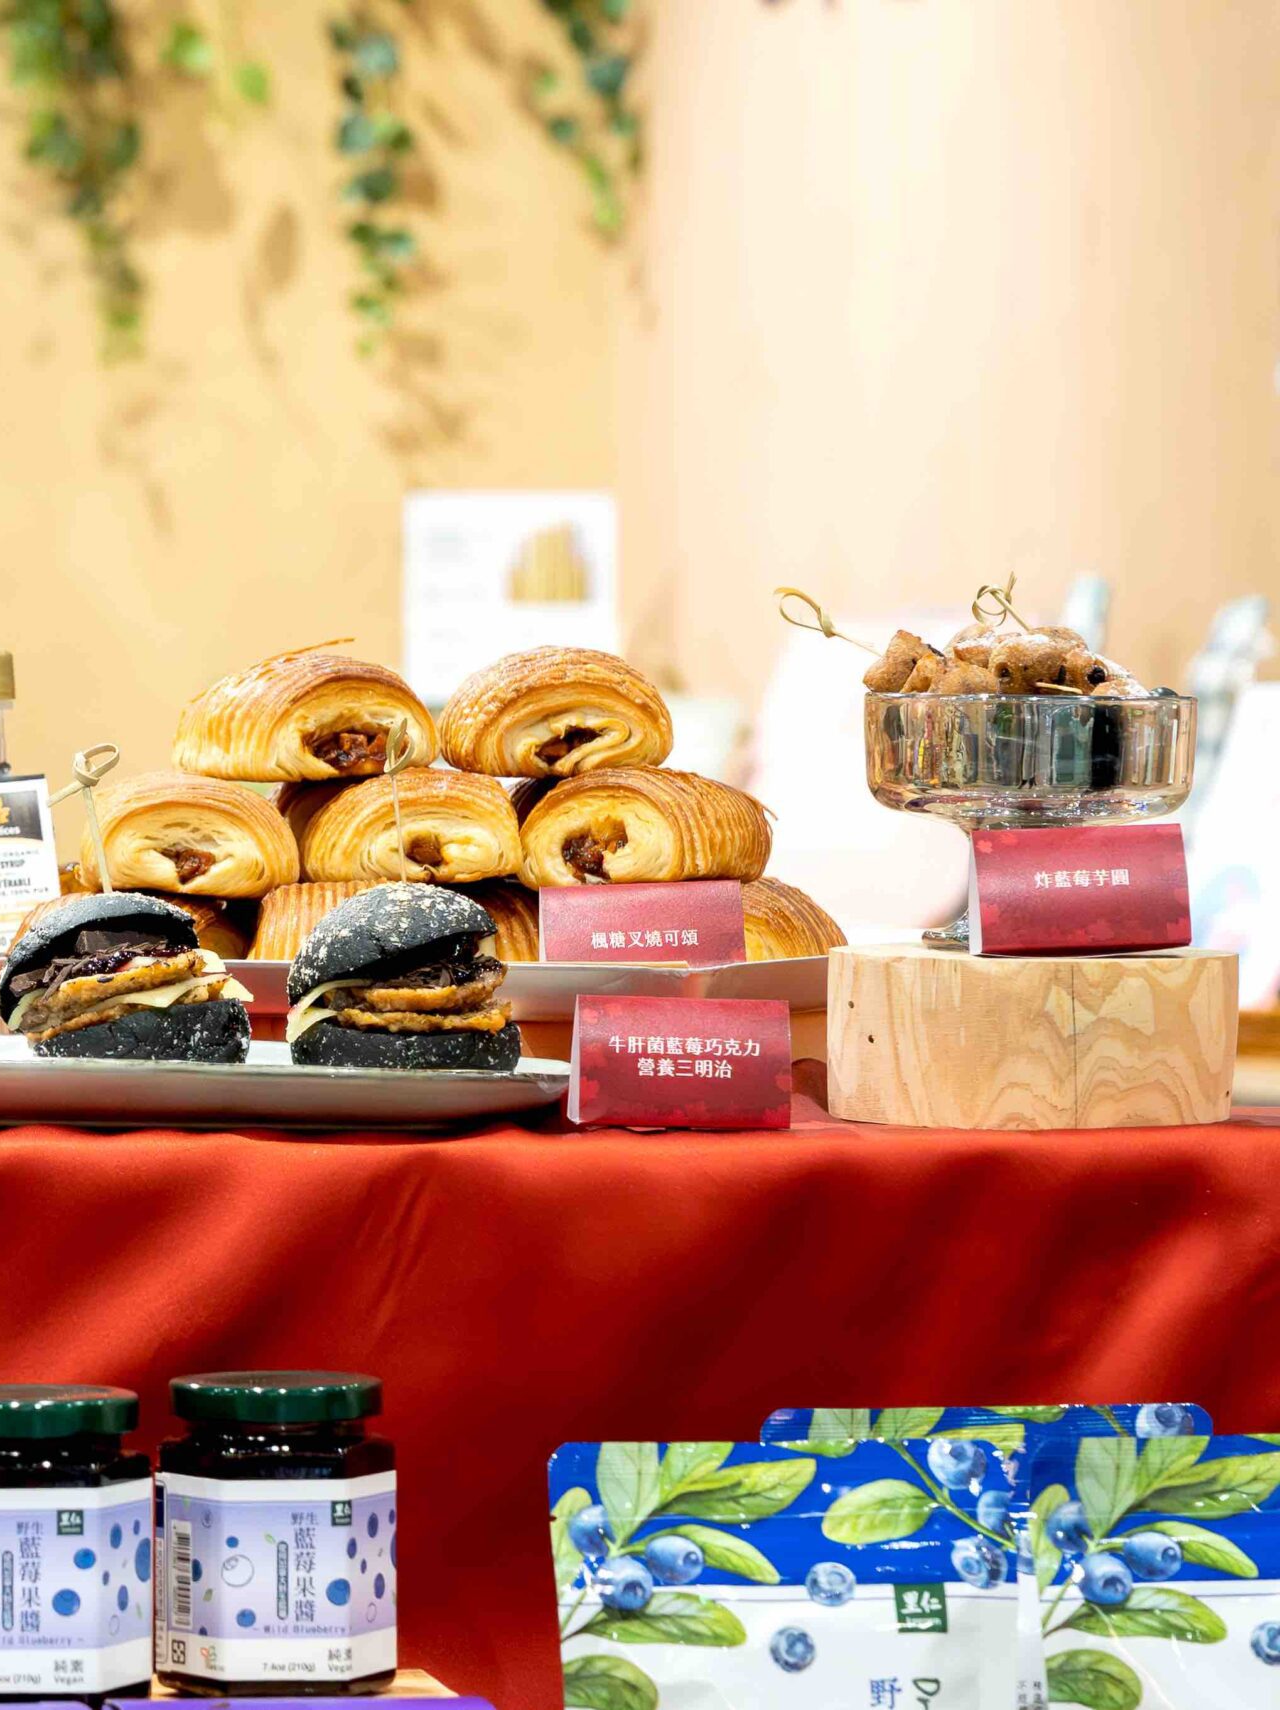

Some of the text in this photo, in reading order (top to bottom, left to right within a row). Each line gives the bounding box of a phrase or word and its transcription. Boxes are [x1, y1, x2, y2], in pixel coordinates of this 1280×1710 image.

[591, 929, 700, 950] 楓糖叉燒可頌
[608, 1035, 761, 1057] 牛肝菌藍莓巧克力
[636, 1057, 733, 1079] 營養三明治
[16, 1520, 43, 1536] 野生
[291, 1511, 319, 1526] 野生
[901, 1590, 943, 1614] 里仁
